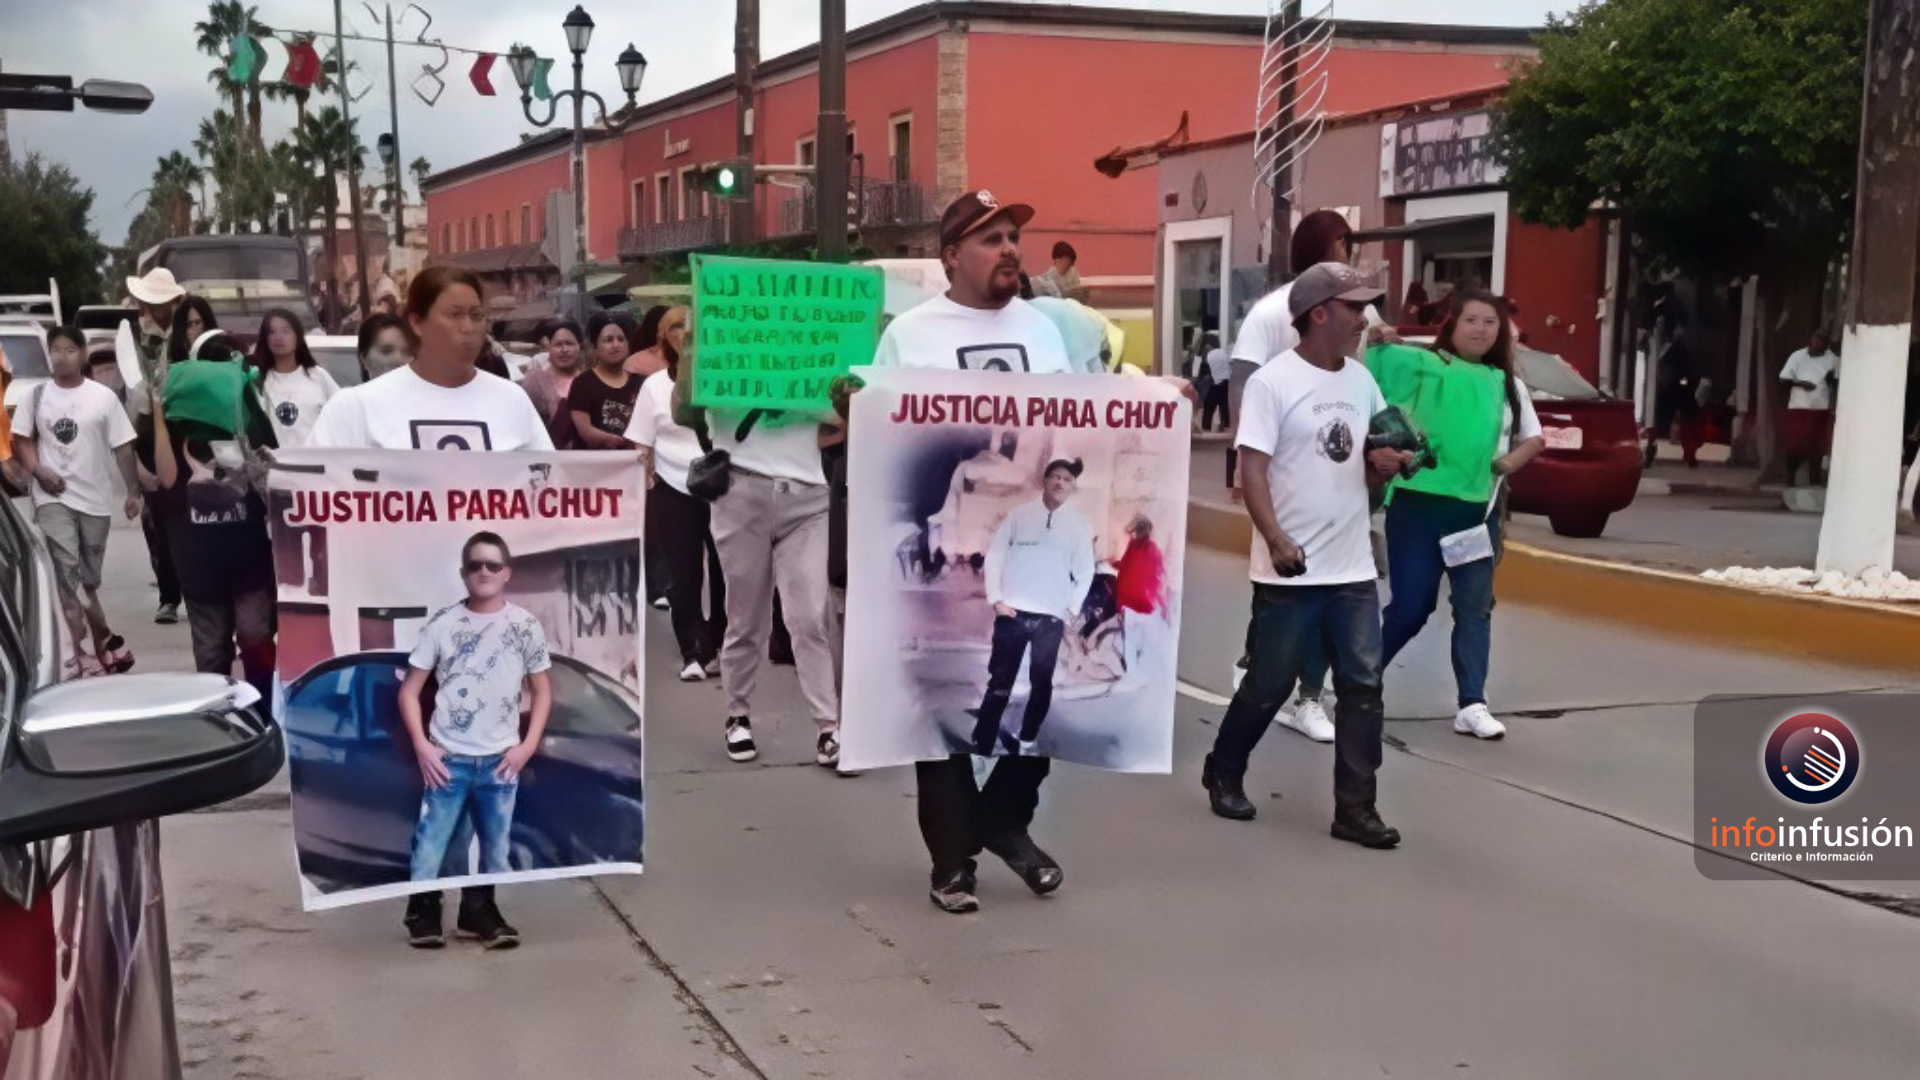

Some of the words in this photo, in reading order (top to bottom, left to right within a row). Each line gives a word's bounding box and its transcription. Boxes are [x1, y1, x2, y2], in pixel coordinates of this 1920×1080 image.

[890, 393, 1020, 427] JUSTICIA
[1026, 397, 1098, 428] PARA
[1105, 400, 1178, 429] CHUY
[288, 490, 437, 523] JUSTICIA
[447, 489, 530, 521] PARA
